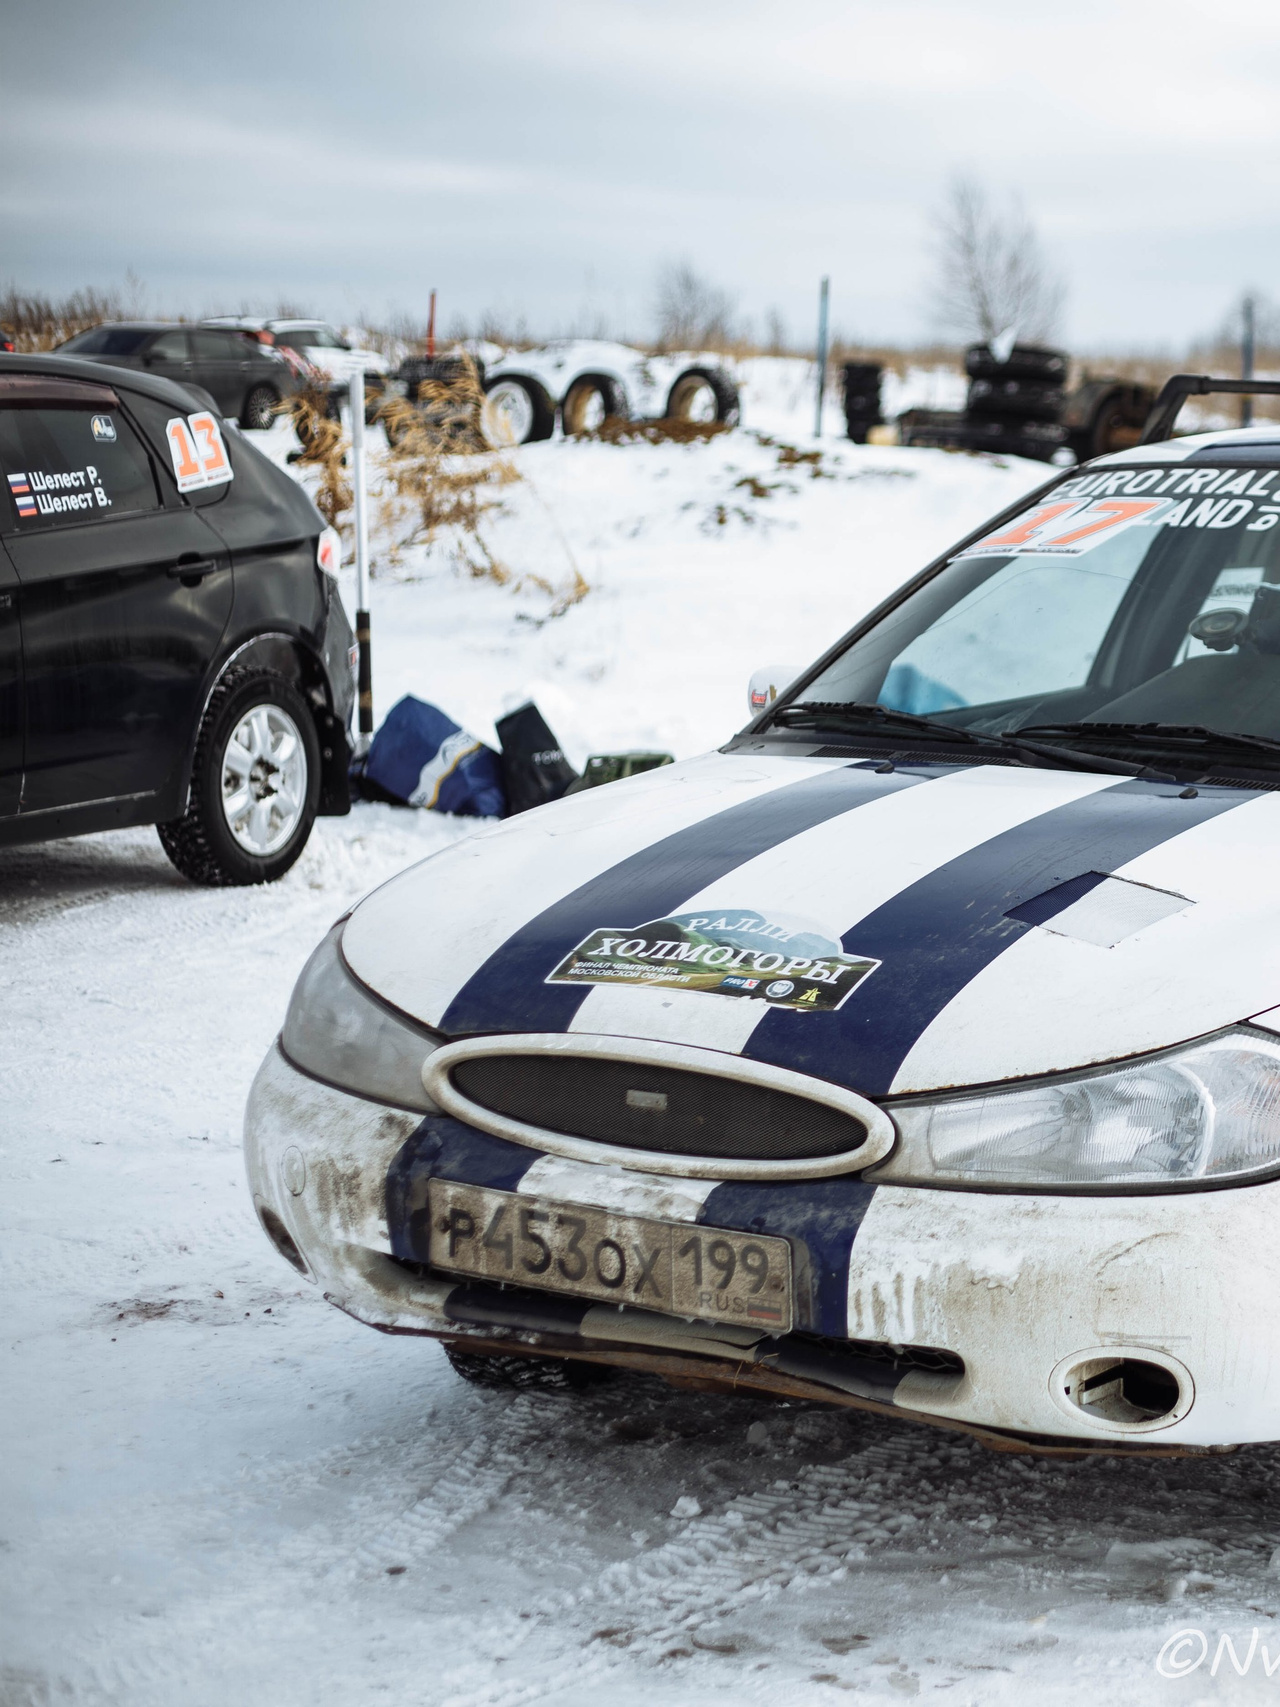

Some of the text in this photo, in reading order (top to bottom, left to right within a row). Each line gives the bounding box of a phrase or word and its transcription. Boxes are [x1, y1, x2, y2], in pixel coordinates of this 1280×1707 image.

[171, 417, 226, 477] 13
[28, 465, 102, 491] Шелест Р.
[1046, 467, 1280, 500] EUROTRIAL
[36, 487, 112, 515] Шелест В.
[966, 500, 1164, 548] 17
[683, 917, 798, 943] РАЛЛИ
[574, 961, 680, 975] ФИНАЛ ЧЕМПИОНАТА
[587, 937, 852, 984] ХОЛМОГОРЫ
[567, 968, 692, 983] МОСКОВСКОЙ ОБЛАСТИ
[678, 1235, 769, 1295] 199
[699, 1291, 746, 1315] RUS
